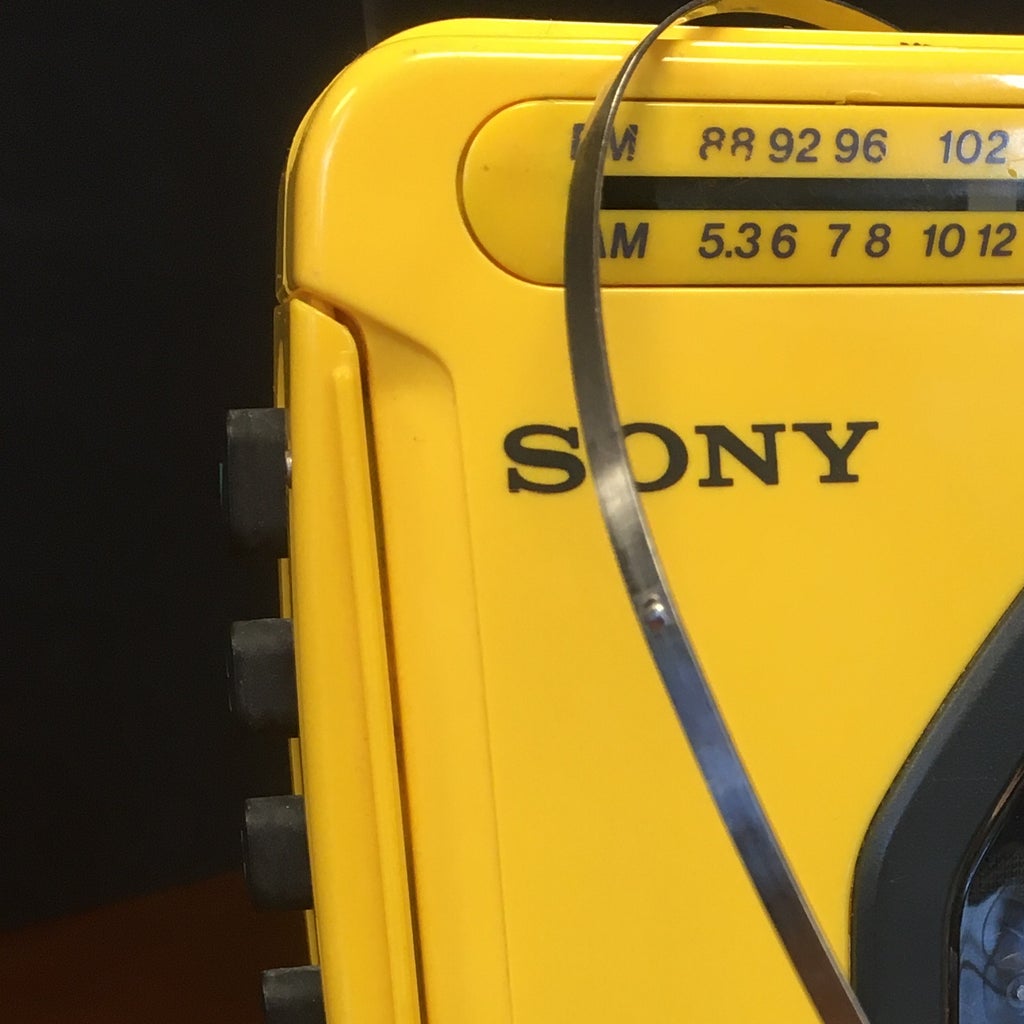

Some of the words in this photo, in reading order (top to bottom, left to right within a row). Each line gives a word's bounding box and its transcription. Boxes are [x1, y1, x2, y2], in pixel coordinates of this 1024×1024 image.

[699, 126, 756, 161] 88
[769, 127, 821, 163] 92
[834, 128, 888, 163] 96
[939, 129, 1010, 164] 102
[599, 222, 650, 259] M
[828, 223, 852, 257] 7
[864, 223, 892, 258] 8
[923, 223, 966, 258] 10
[977, 222, 1018, 257] 12
[503, 421, 879, 494] SONY
